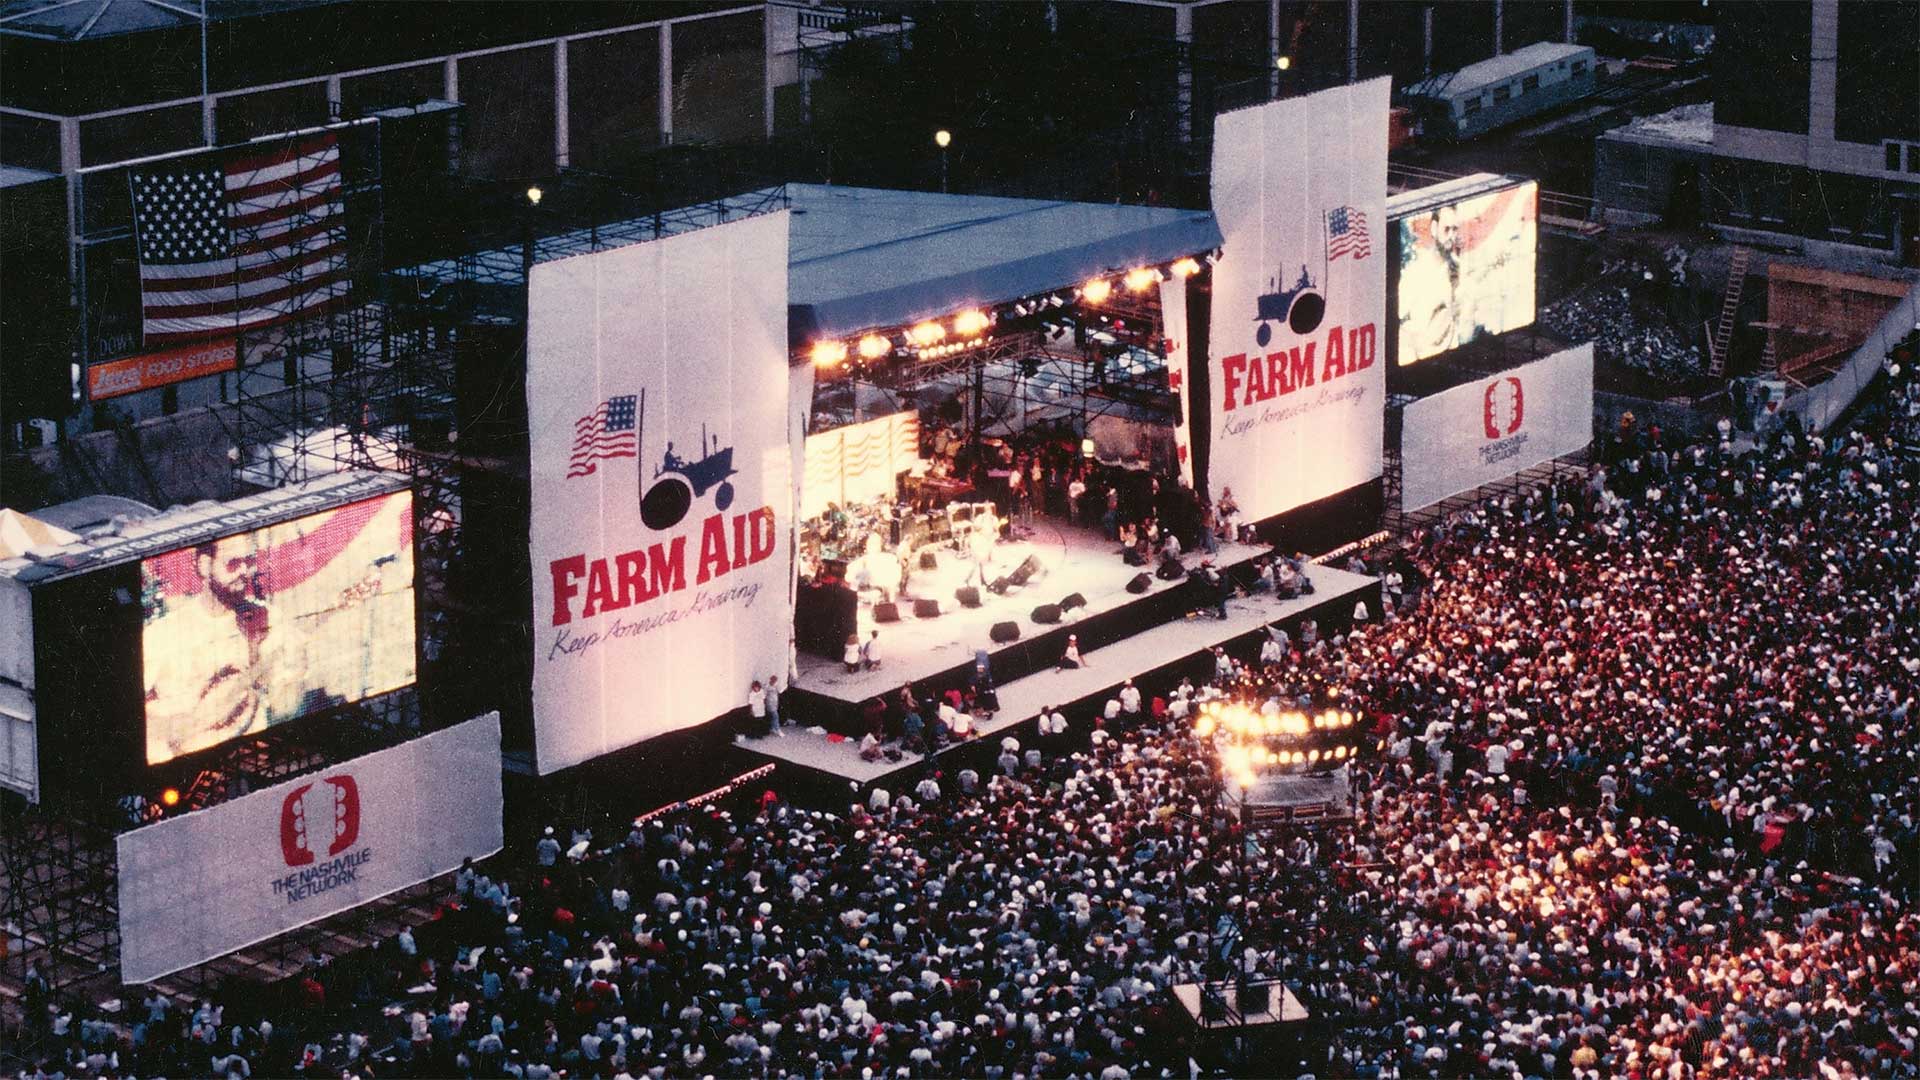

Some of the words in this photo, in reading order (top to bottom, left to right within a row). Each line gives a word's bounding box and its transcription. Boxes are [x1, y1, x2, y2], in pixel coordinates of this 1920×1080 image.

[146, 358, 184, 377] FOOD
[186, 346, 236, 369] STORES
[1222, 341, 1318, 412] FARM
[1321, 322, 1377, 384] AID
[1220, 413, 1257, 440] Keep
[220, 495, 326, 526] DIAMOND
[550, 536, 687, 627] FARM
[696, 505, 776, 586] AID
[548, 629, 603, 661] Keep
[603, 616, 679, 642] America
[271, 873, 297, 895] THE
[299, 847, 371, 884] NASHVILLE
[287, 867, 357, 905] NETWORK
